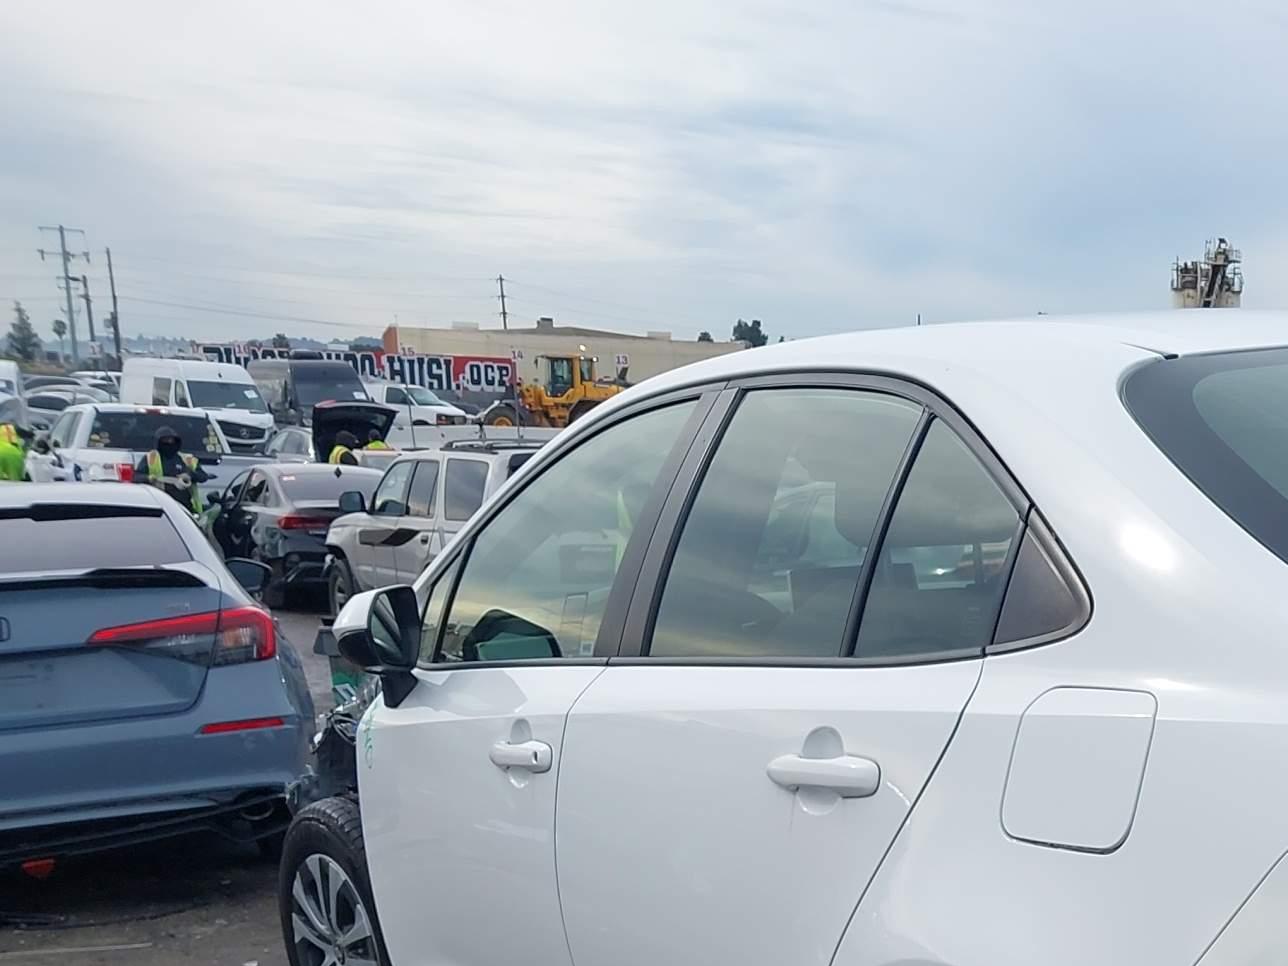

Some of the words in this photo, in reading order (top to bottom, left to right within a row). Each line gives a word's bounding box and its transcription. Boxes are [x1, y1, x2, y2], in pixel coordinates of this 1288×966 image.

[401, 346, 415, 356] 15
[511, 350, 524, 360] 14
[616, 355, 628, 365] 13
